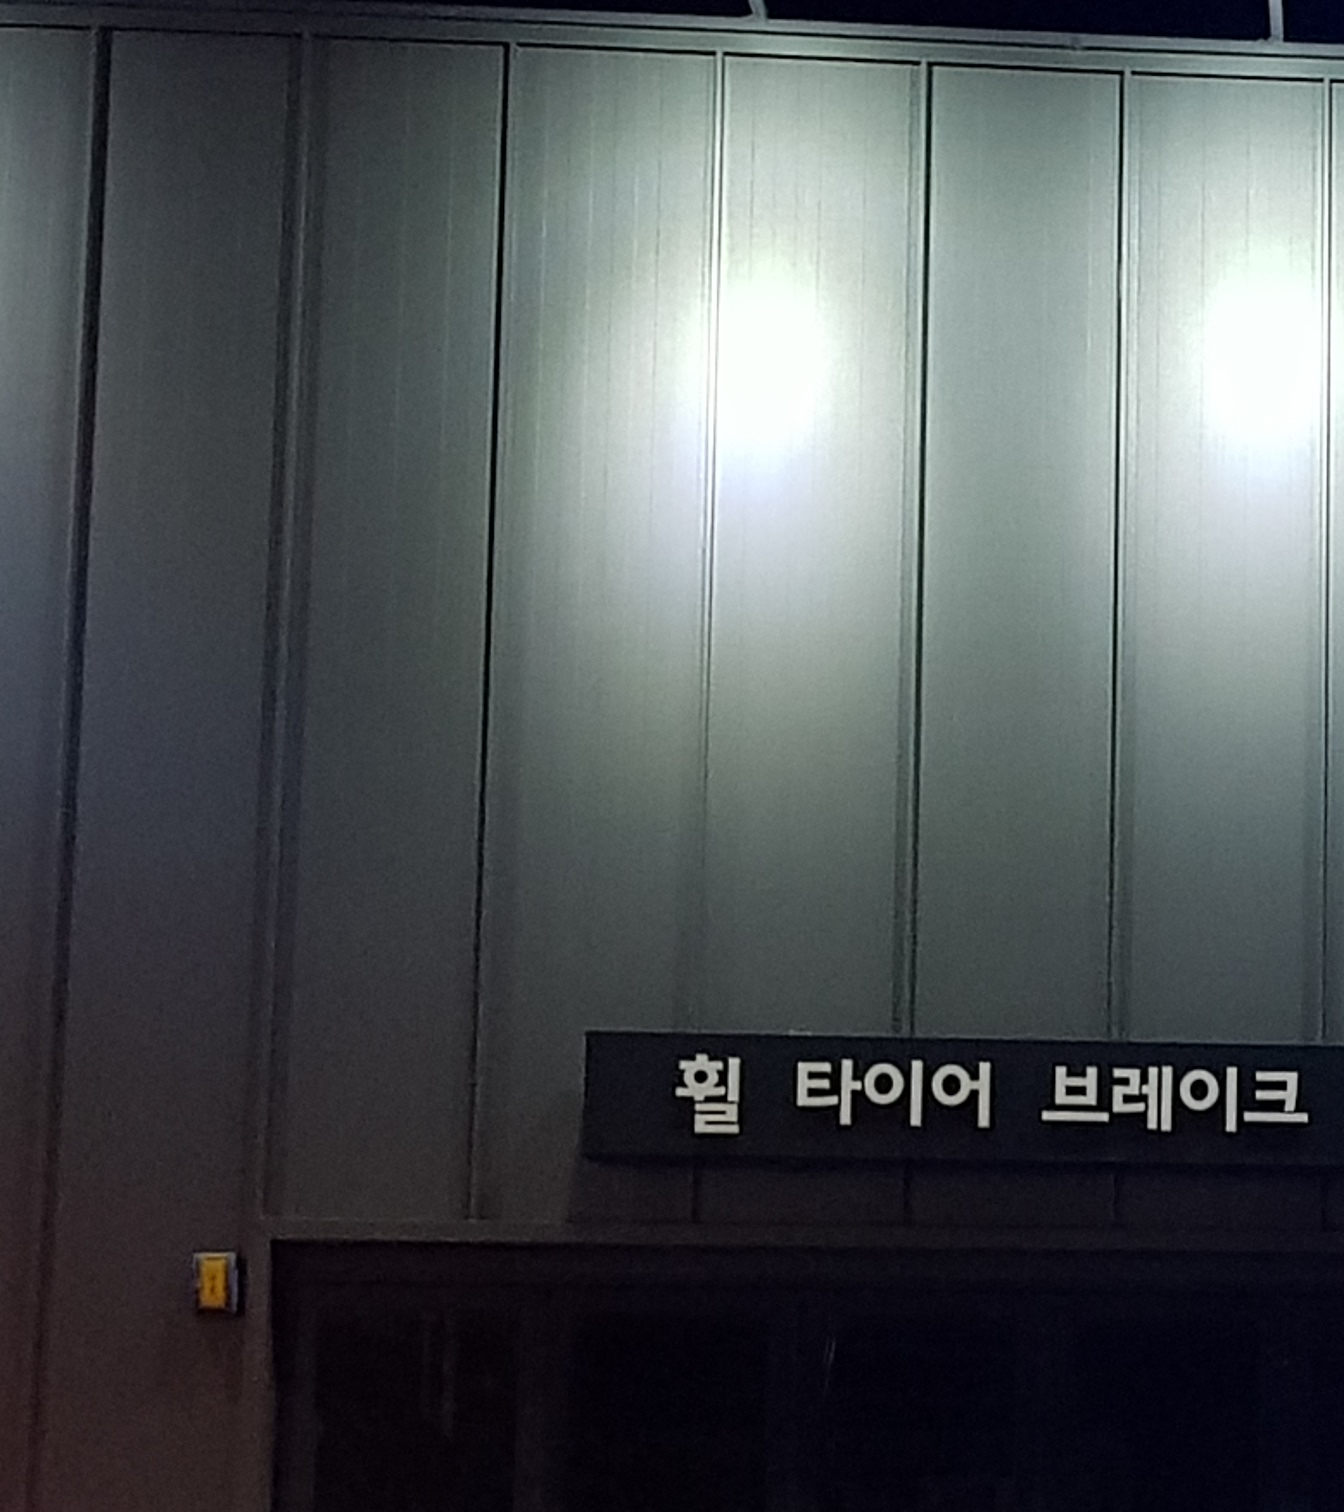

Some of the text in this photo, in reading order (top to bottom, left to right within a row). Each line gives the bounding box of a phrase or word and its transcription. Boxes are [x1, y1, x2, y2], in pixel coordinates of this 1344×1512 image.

[676, 1053, 740, 1134] 휠
[796, 1058, 992, 1128] 타이어
[1041, 1065, 1309, 1133] 브레이크
